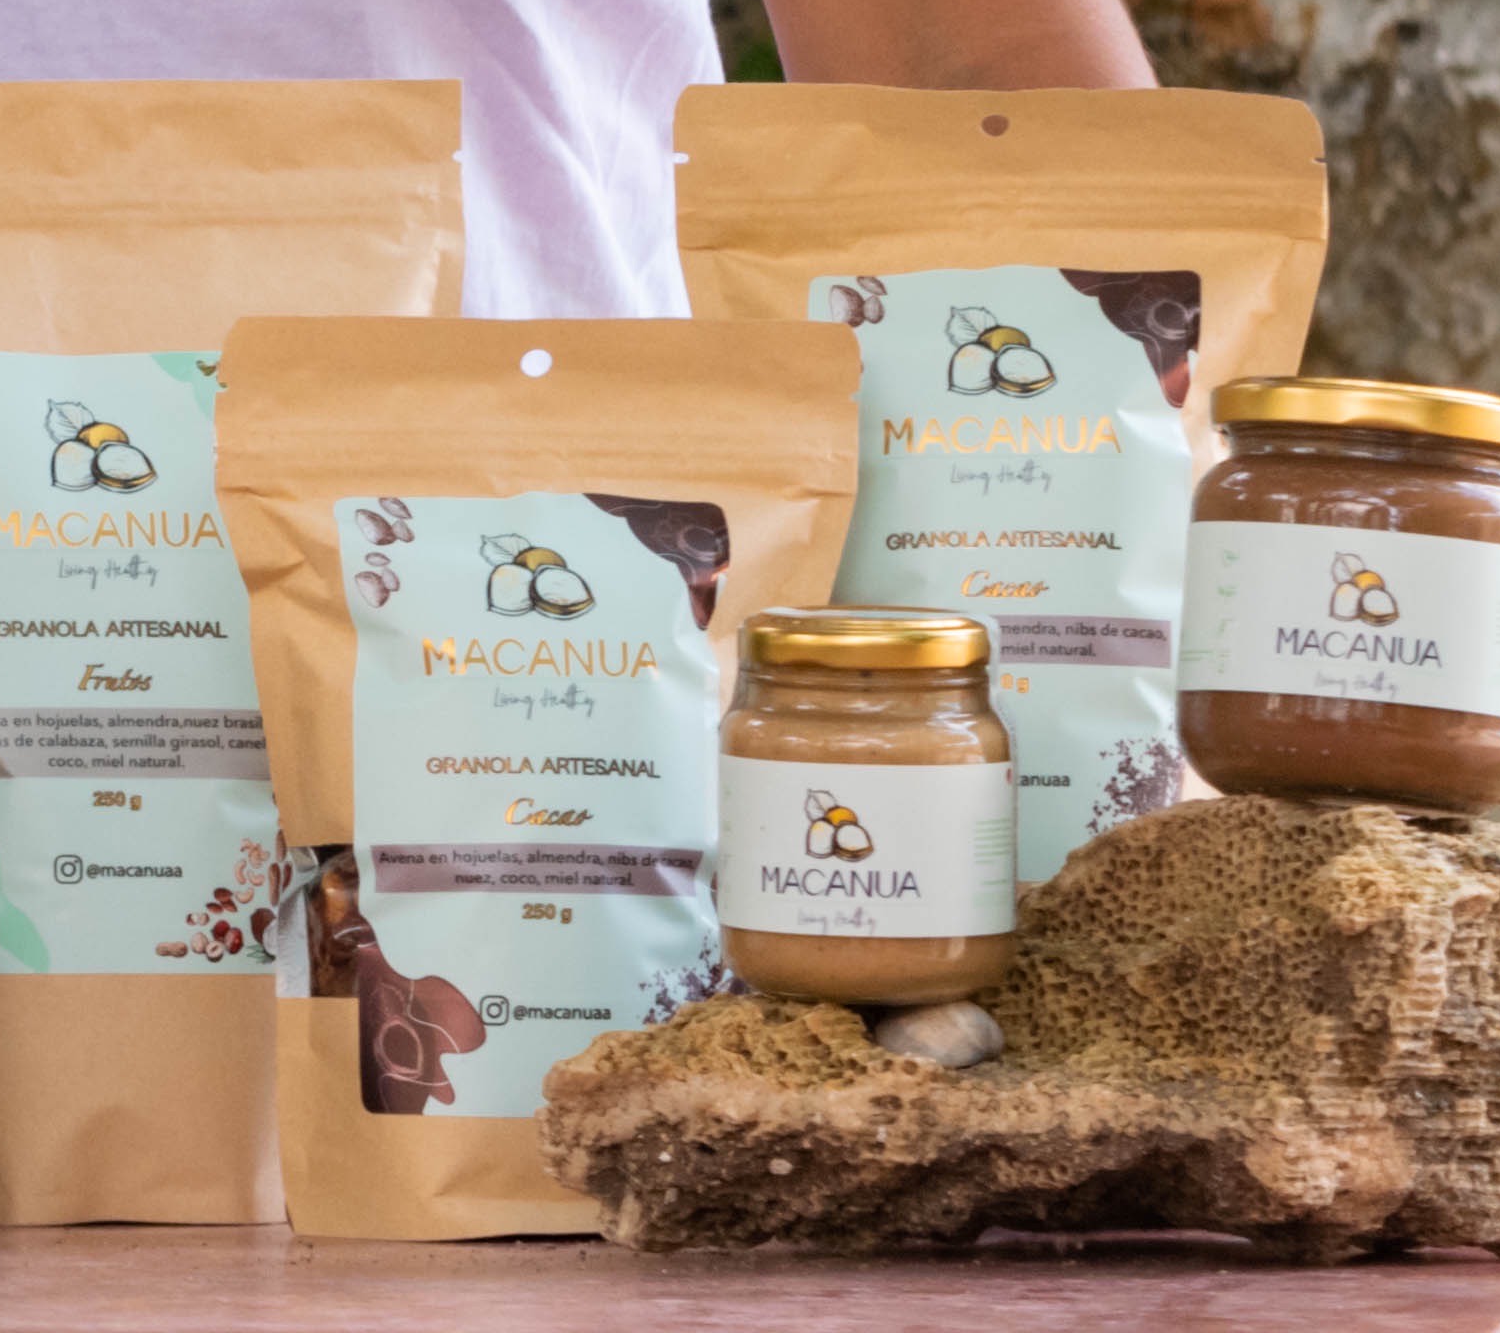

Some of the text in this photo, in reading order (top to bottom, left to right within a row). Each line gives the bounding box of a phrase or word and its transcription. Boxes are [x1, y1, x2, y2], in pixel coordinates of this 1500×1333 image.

[882, 415, 1122, 455] MACANUA
[885, 530, 1122, 551] GRANOLA ARTESANAL
[960, 570, 1050, 598] Cacao
[105, 620, 229, 638] ARTESANAL
[1000, 622, 1061, 637] mendra,
[1065, 622, 1097, 636] nibs
[1101, 624, 1119, 637] de
[1039, 643, 1097, 657] natural.
[1275, 626, 1443, 668] MACANUA
[421, 636, 660, 679] MACANUA
[13, 717, 32, 727] en
[36, 713, 103, 730] hojuelas,
[14, 734, 33, 747] de
[38, 734, 108, 749] calabaza,
[112, 734, 166, 748] semilla
[169, 735, 225, 752] girasol,
[228, 737, 266, 750] canel
[92, 754, 124, 767] miel
[128, 754, 185, 768] natural.
[425, 755, 661, 778] GRANOLA ARTESANAL
[1019, 774, 1071, 787] anuaa
[92, 790, 143, 811] 250 g
[504, 797, 595, 826] Cacao
[378, 851, 425, 864] Avena
[428, 853, 448, 864] en
[452, 849, 523, 866] hojuelas,
[527, 850, 605, 866] almendra,
[607, 851, 638, 866] nibs
[86, 863, 183, 879] @macanuaa
[455, 873, 496, 885] nuez,
[500, 873, 542, 886] coco,
[544, 872, 580, 885] miel
[760, 865, 920, 899] MACANUA
[521, 903, 573, 924] 250 g
[512, 1004, 612, 1021] @macanuaa
